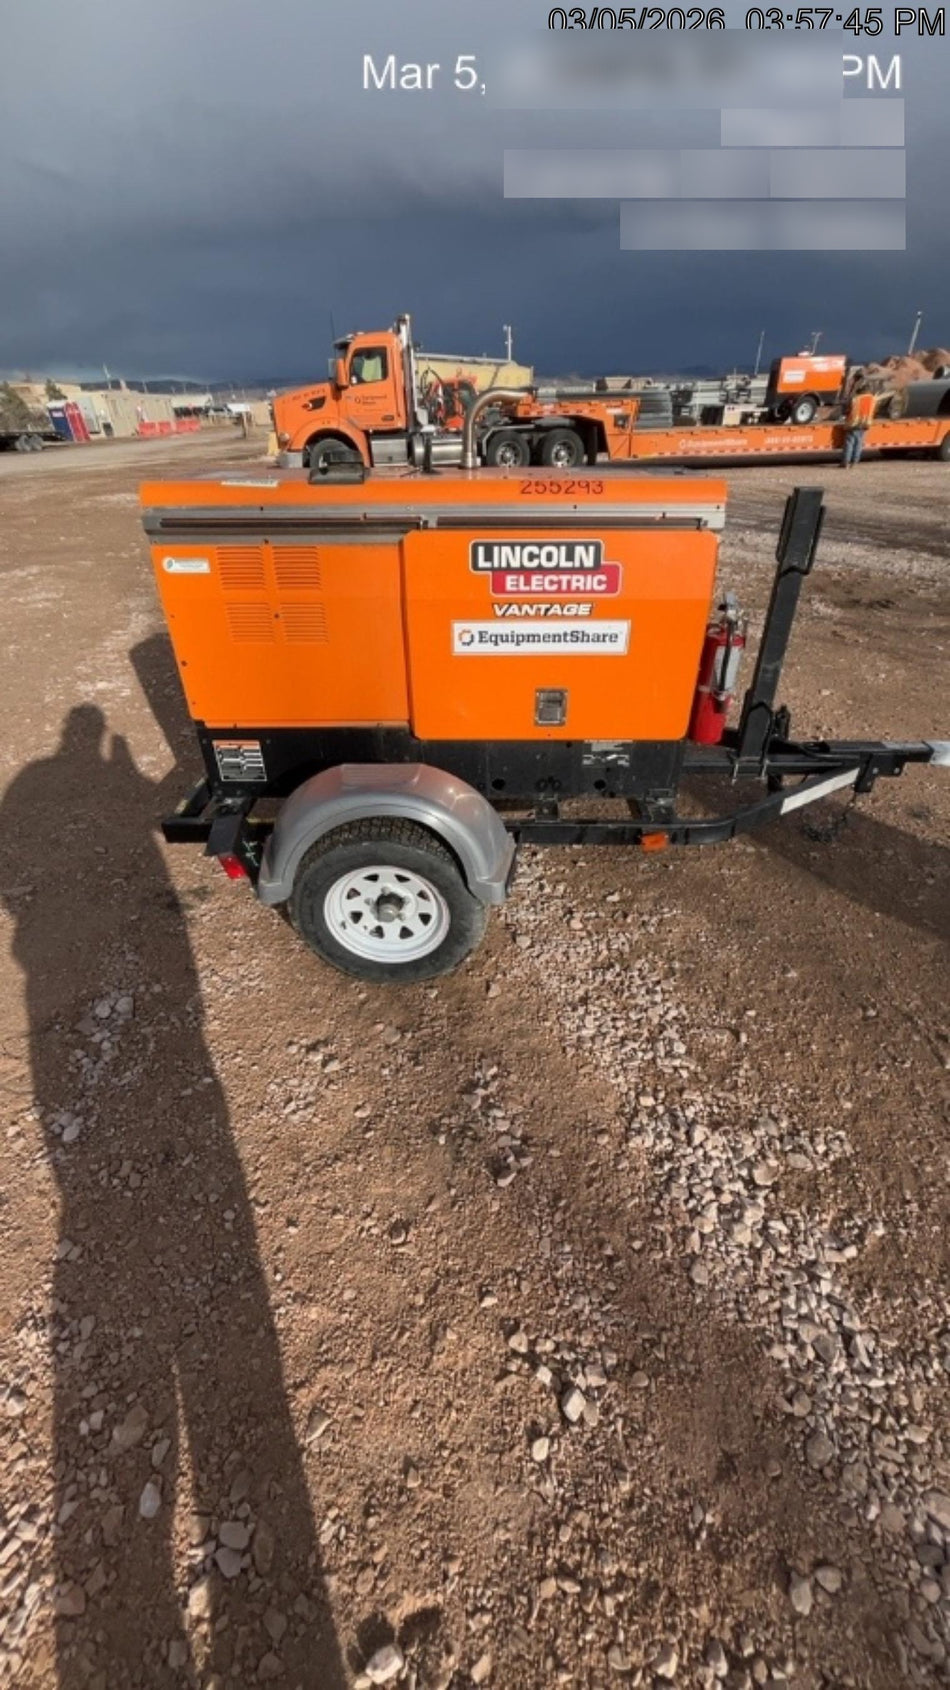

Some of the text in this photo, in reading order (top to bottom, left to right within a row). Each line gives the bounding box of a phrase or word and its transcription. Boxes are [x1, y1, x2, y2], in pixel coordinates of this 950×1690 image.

[519, 479, 605, 495] 255293
[477, 545, 595, 569] LINCOLN
[504, 573, 608, 591] ELECTRIC
[492, 603, 593, 617] VANTAGE
[477, 630, 619, 647] EquipmentShare
